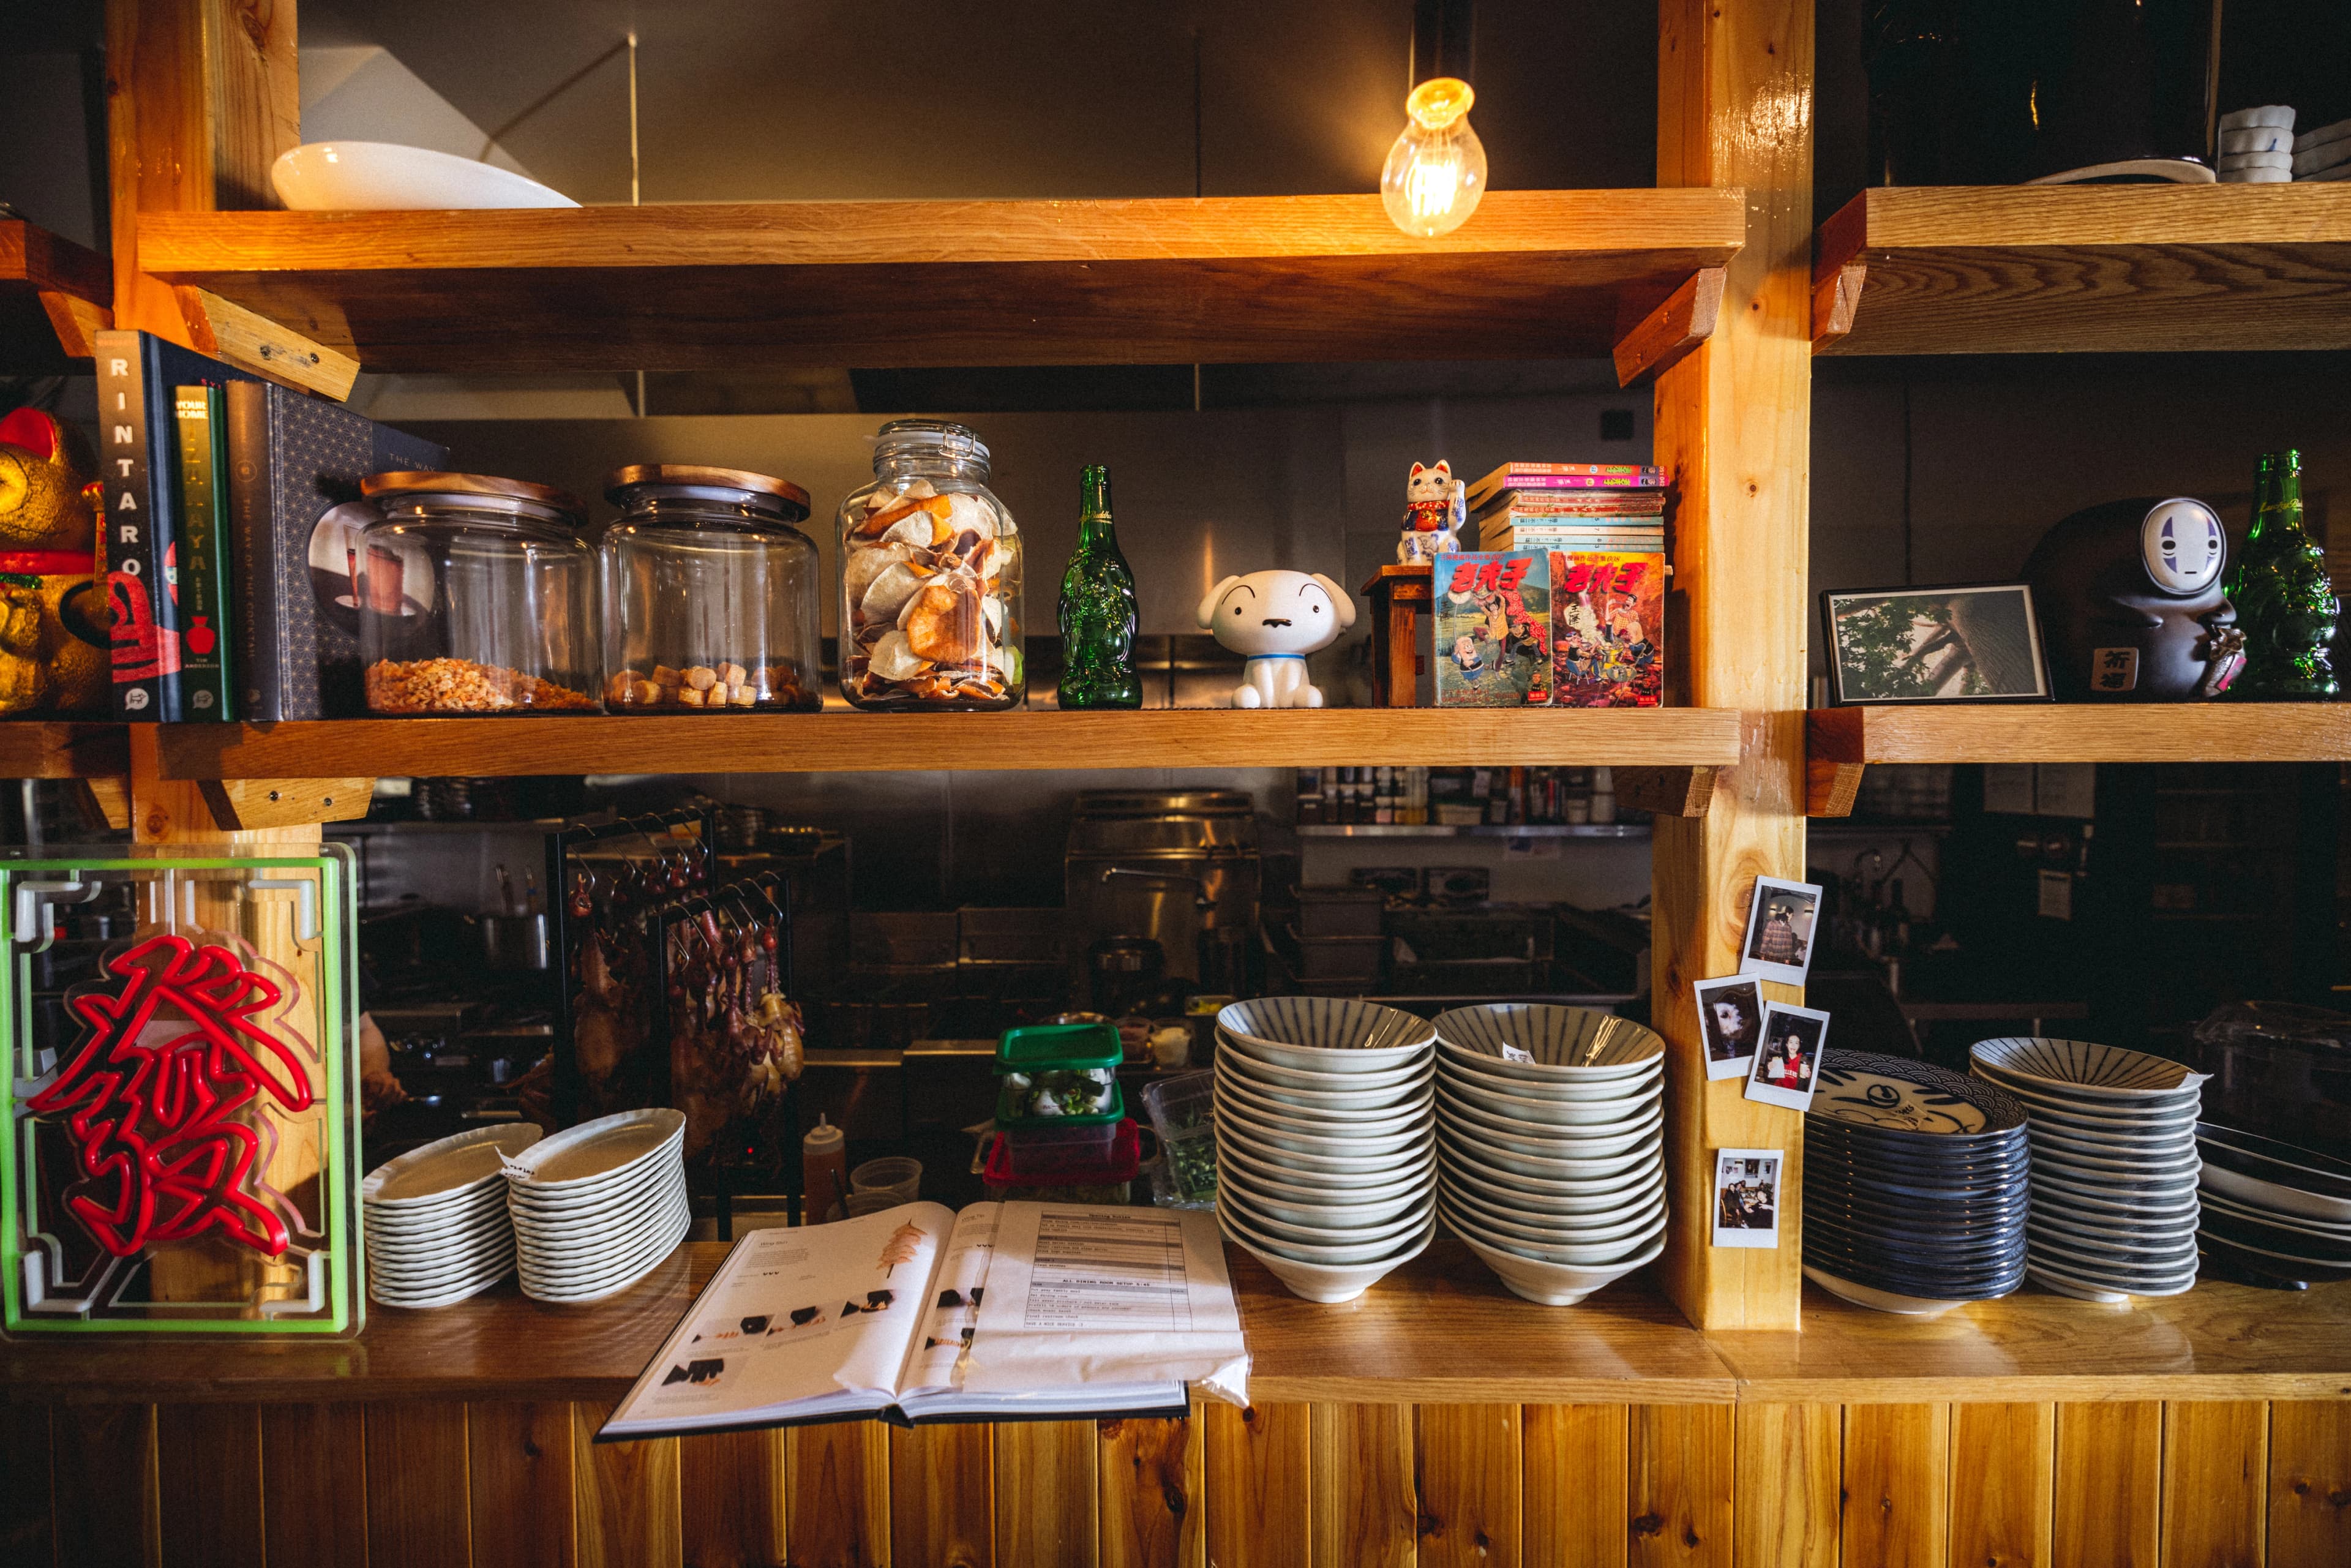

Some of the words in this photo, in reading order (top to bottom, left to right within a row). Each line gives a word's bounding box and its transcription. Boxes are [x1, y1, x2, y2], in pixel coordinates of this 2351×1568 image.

[175, 400, 207, 410] YOUR
[175, 410, 209, 419] HOME
[110, 358, 142, 577] RINTARO
[389, 452, 410, 466] THE
[414, 461, 435, 473] WAY
[247, 555, 253, 569] OF
[1449, 558, 1534, 593] 老夫子
[1564, 561, 1649, 594] 老夫子
